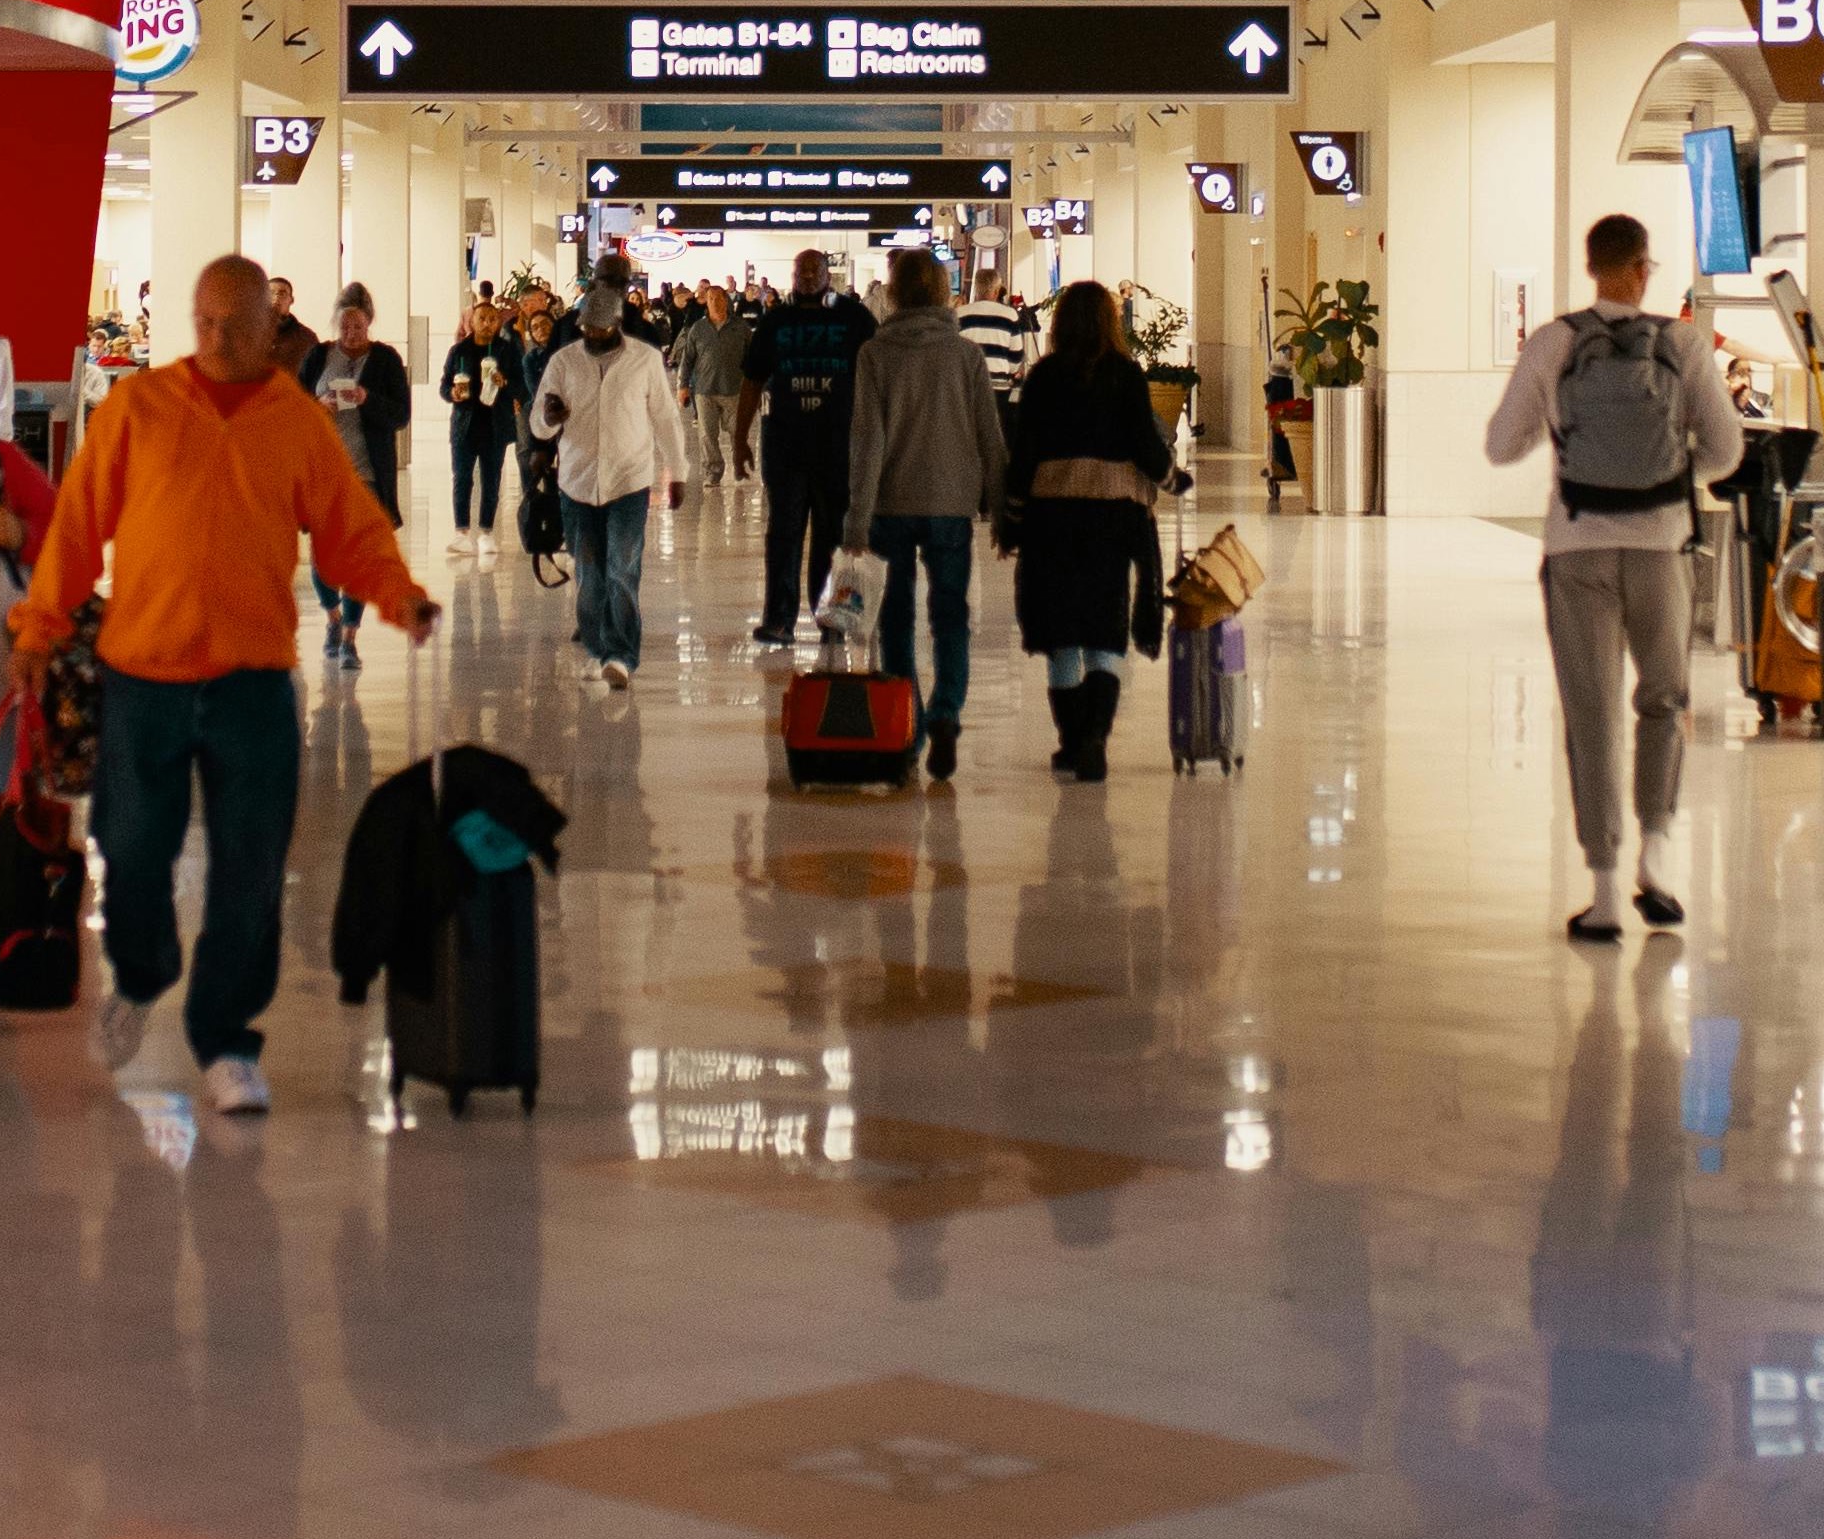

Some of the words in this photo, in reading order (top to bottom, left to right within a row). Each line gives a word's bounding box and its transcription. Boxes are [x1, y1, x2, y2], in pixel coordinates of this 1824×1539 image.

[126, 8, 185, 49] ING
[662, 22, 734, 47] Gates
[738, 22, 813, 47] B1-B4
[860, 22, 909, 51] Bag
[912, 22, 982, 47] Claim
[661, 51, 762, 76] Terminal
[860, 50, 986, 75] Restrooms
[255, 118, 310, 154] B3
[782, 172, 831, 186] Terminal
[1027, 208, 1054, 226] B2
[1055, 200, 1085, 220] B4
[562, 215, 585, 231] B1
[791, 376, 833, 393] BULK
[800, 396, 823, 412] UP
